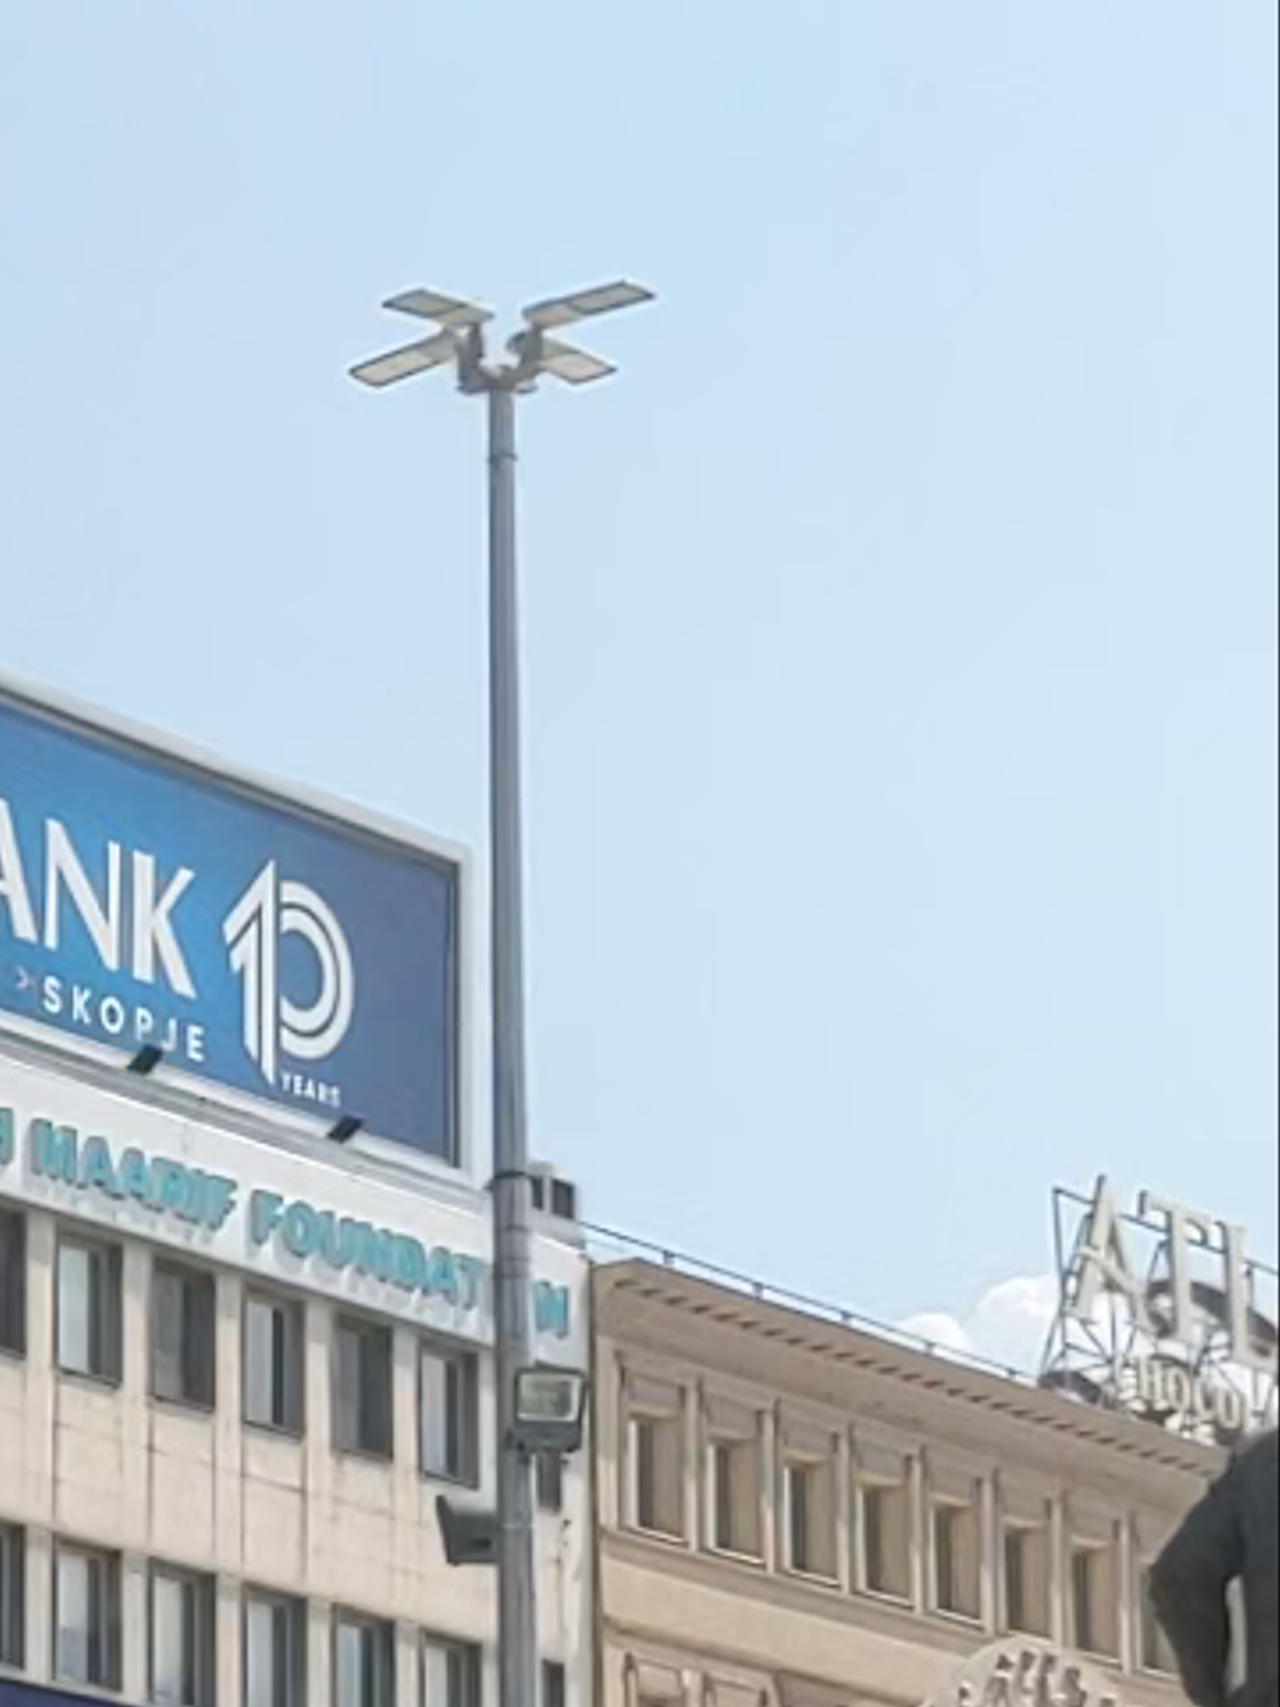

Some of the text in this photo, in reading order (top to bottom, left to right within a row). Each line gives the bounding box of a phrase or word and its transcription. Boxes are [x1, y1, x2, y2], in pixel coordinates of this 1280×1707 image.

[42, 975, 206, 1064] SKOPJE
[222, 858, 355, 1087] 10
[280, 1072, 342, 1108] YEARS
[28, 1117, 238, 1232] MAARIF
[250, 1189, 569, 1340] FOUNDATN
